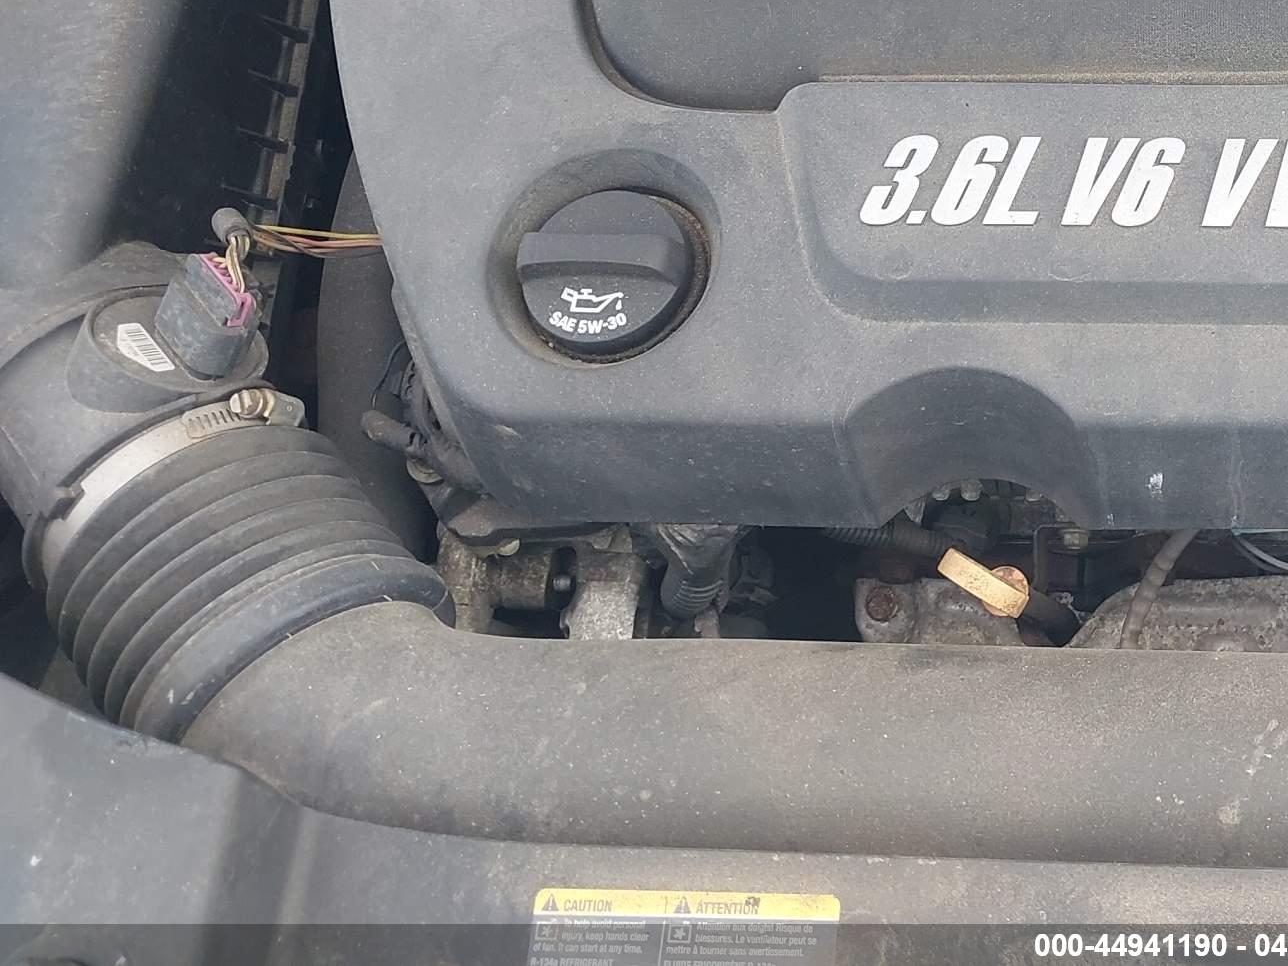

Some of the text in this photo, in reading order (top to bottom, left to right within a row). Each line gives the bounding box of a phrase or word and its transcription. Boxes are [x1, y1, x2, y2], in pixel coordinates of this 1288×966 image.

[859, 134, 1042, 226] 3.6L
[1061, 136, 1187, 227] V6
[549, 311, 627, 334] SAE 5W-30
[563, 899, 613, 912] CAUTION
[696, 900, 761, 915] ATTENTION
[574, 918, 590, 930] help
[591, 919, 612, 929] avoid
[613, 919, 646, 930] personal
[802, 922, 814, 933] de
[585, 931, 604, 942] keep
[735, 934, 745, 943] Le
[788, 936, 806, 947] peut
[807, 937, 817, 946] se
[564, 944, 579, 953] can
[580, 944, 598, 953] start
[599, 944, 607, 953] at
[608, 944, 622, 954] any
[666, 945, 692, 955] mettre
